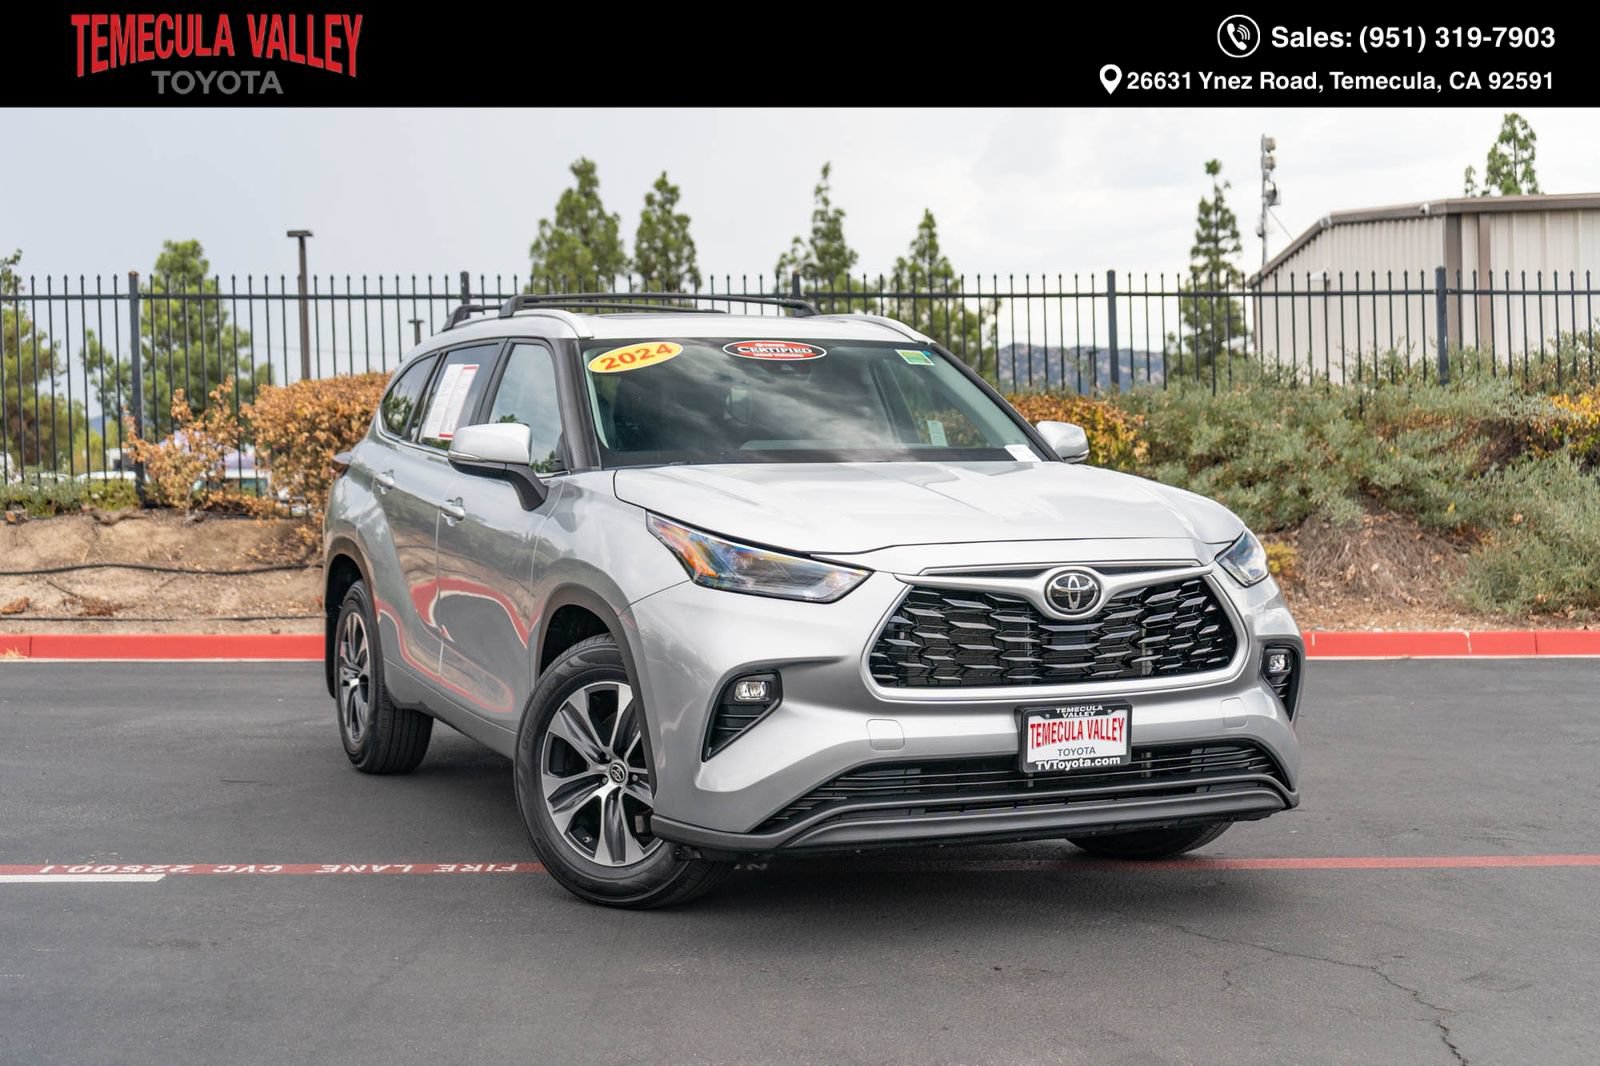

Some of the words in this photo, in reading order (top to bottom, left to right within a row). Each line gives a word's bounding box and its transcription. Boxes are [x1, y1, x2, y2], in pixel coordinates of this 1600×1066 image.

[737, 346, 812, 354] CERTIFIED
[600, 344, 673, 370] 2024
[1056, 705, 1103, 713] TEMECULA
[1030, 719, 1083, 749] TEMECULA
[1087, 717, 1125, 742] VALLEY
[1057, 747, 1096, 757] TOYOTA
[1036, 756, 1120, 771] TVToyota.com
[39, 864, 195, 873] 22500.1
[212, 865, 283, 873] CVC
[315, 864, 413, 873] LANE
[434, 864, 518, 872] FIRE
